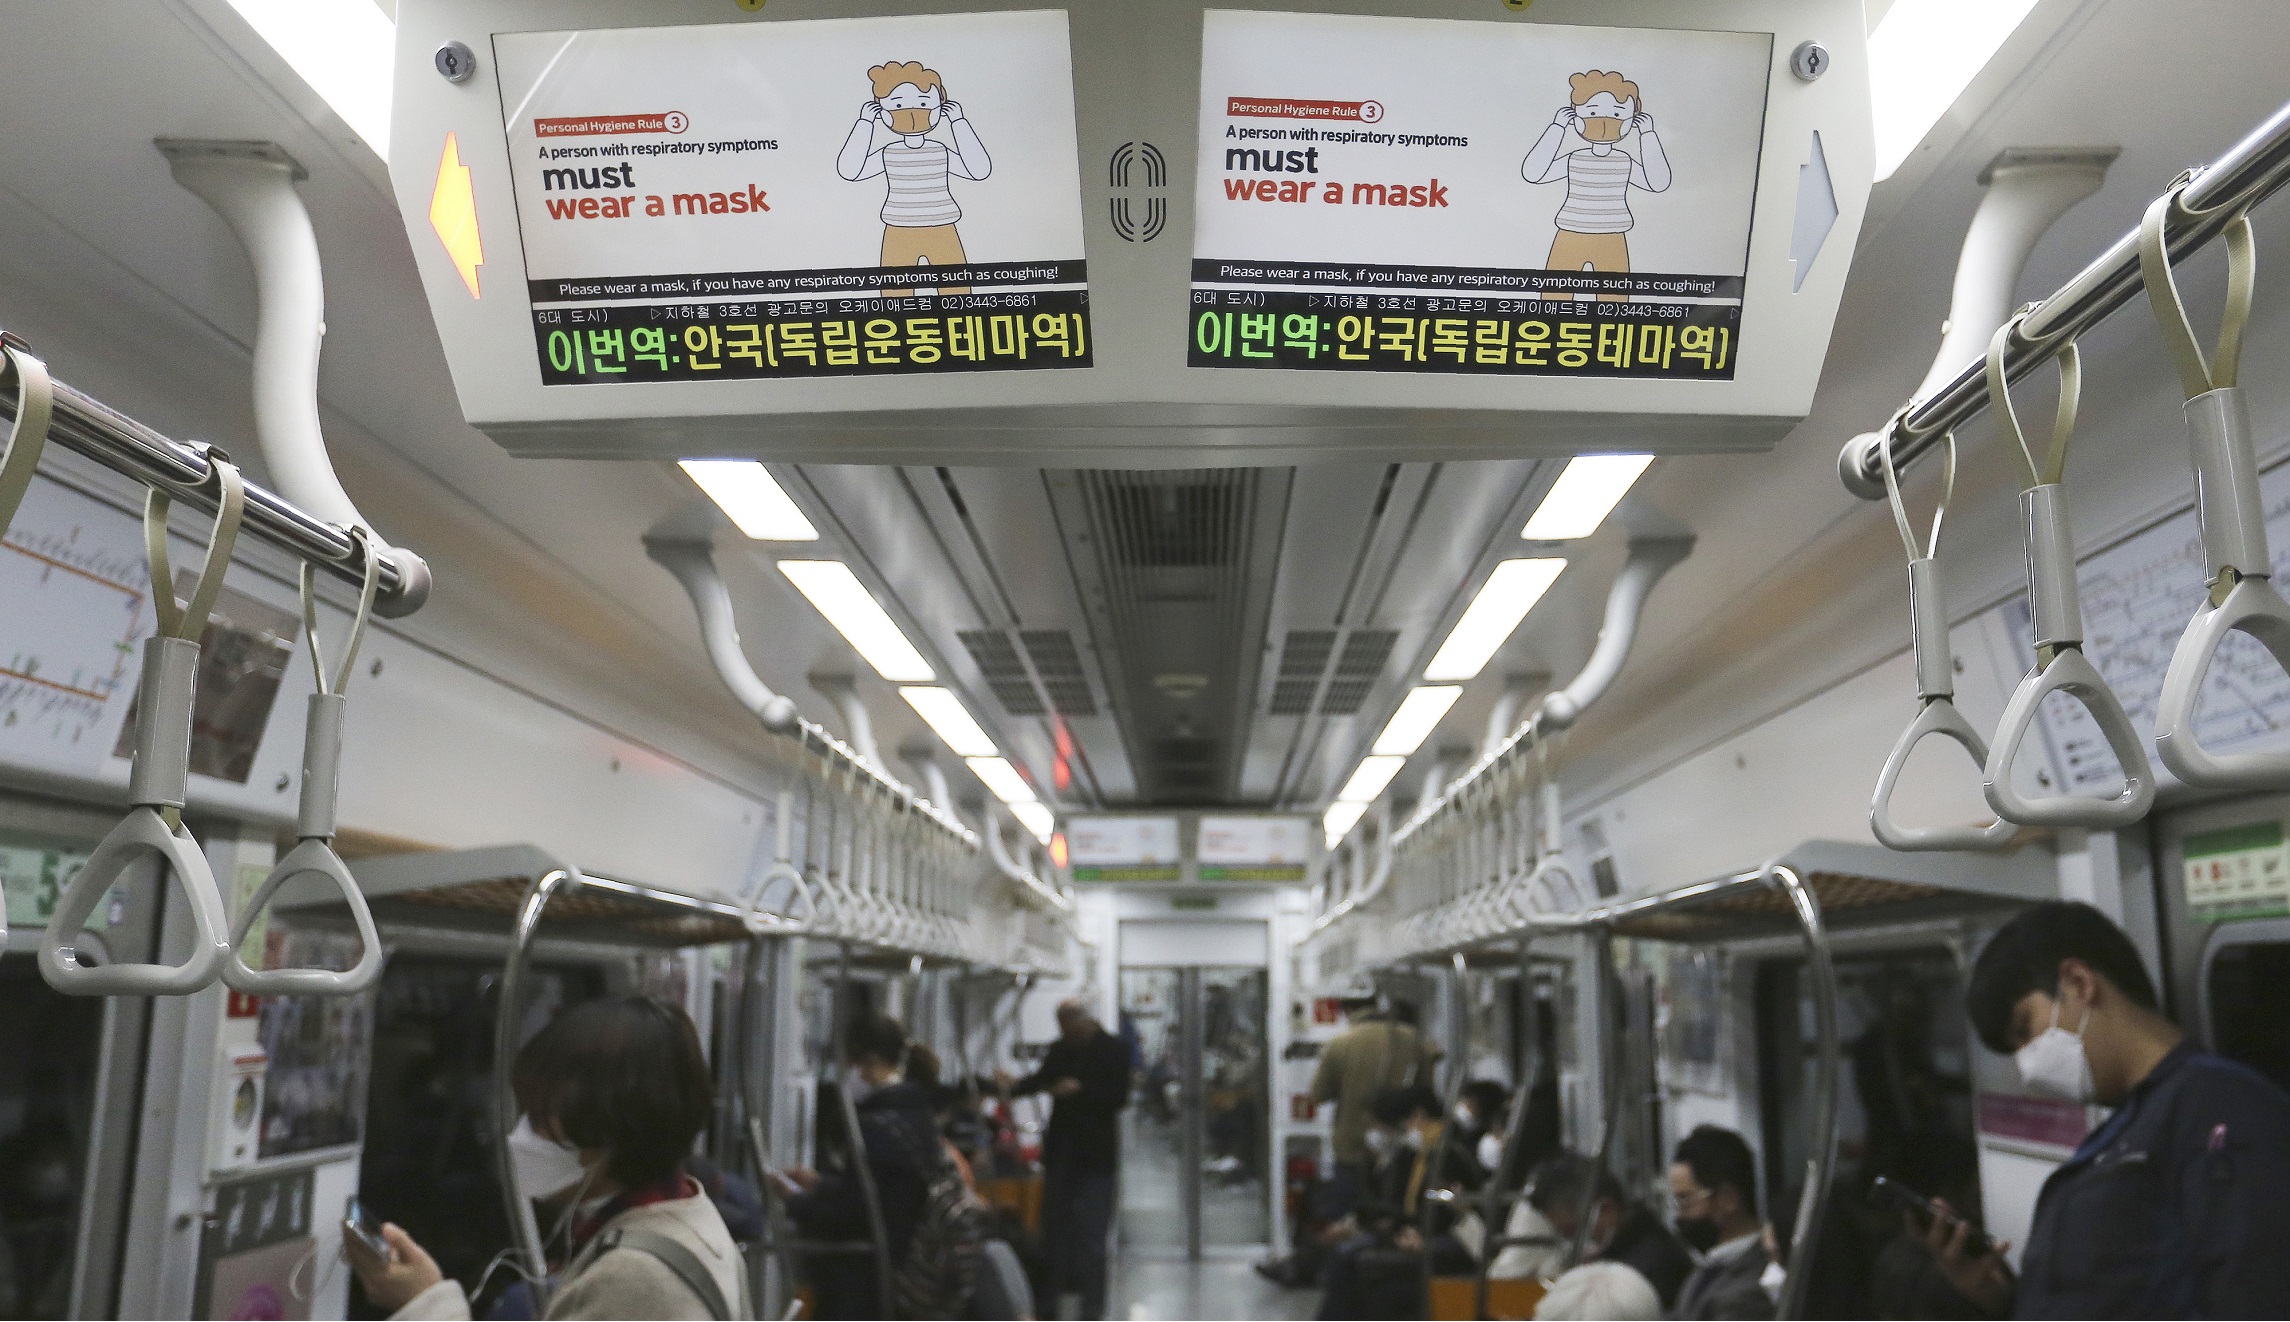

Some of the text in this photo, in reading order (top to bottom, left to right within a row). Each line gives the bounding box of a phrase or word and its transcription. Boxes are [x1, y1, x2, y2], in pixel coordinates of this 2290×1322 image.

[1231, 102, 1376, 118] Personal Hygiene Rule 3
[539, 116, 682, 134] Personal Hygiene Rule 3
[1226, 124, 1468, 147] A person with respiratory symptoms
[538, 138, 778, 161] A person with respiratory symptoms
[1226, 146, 1319, 174] must
[542, 162, 636, 191] must
[545, 183, 771, 220] wear a mask
[1224, 178, 1449, 208] wear a mask
[559, 267, 1059, 296] Please wear a mask, if you have any respiratory symptoms such as coughing!
[1220, 265, 1715, 293] Please wear a mask, if you have any respiratory symptoms such as coughing!
[571, 309, 609, 323] 도시)
[665, 304, 711, 320] 지하철
[719, 303, 758, 318] 3호선
[767, 301, 829, 317] 광고문의
[941, 295, 1038, 311] 02)3443-6861
[1227, 293, 1265, 307] 도시)
[1323, 295, 1369, 309] 지하철
[1378, 297, 1416, 310] 3호선
[1426, 297, 1488, 312] 광고문의
[1597, 302, 1690, 318] 02)3443-6861
